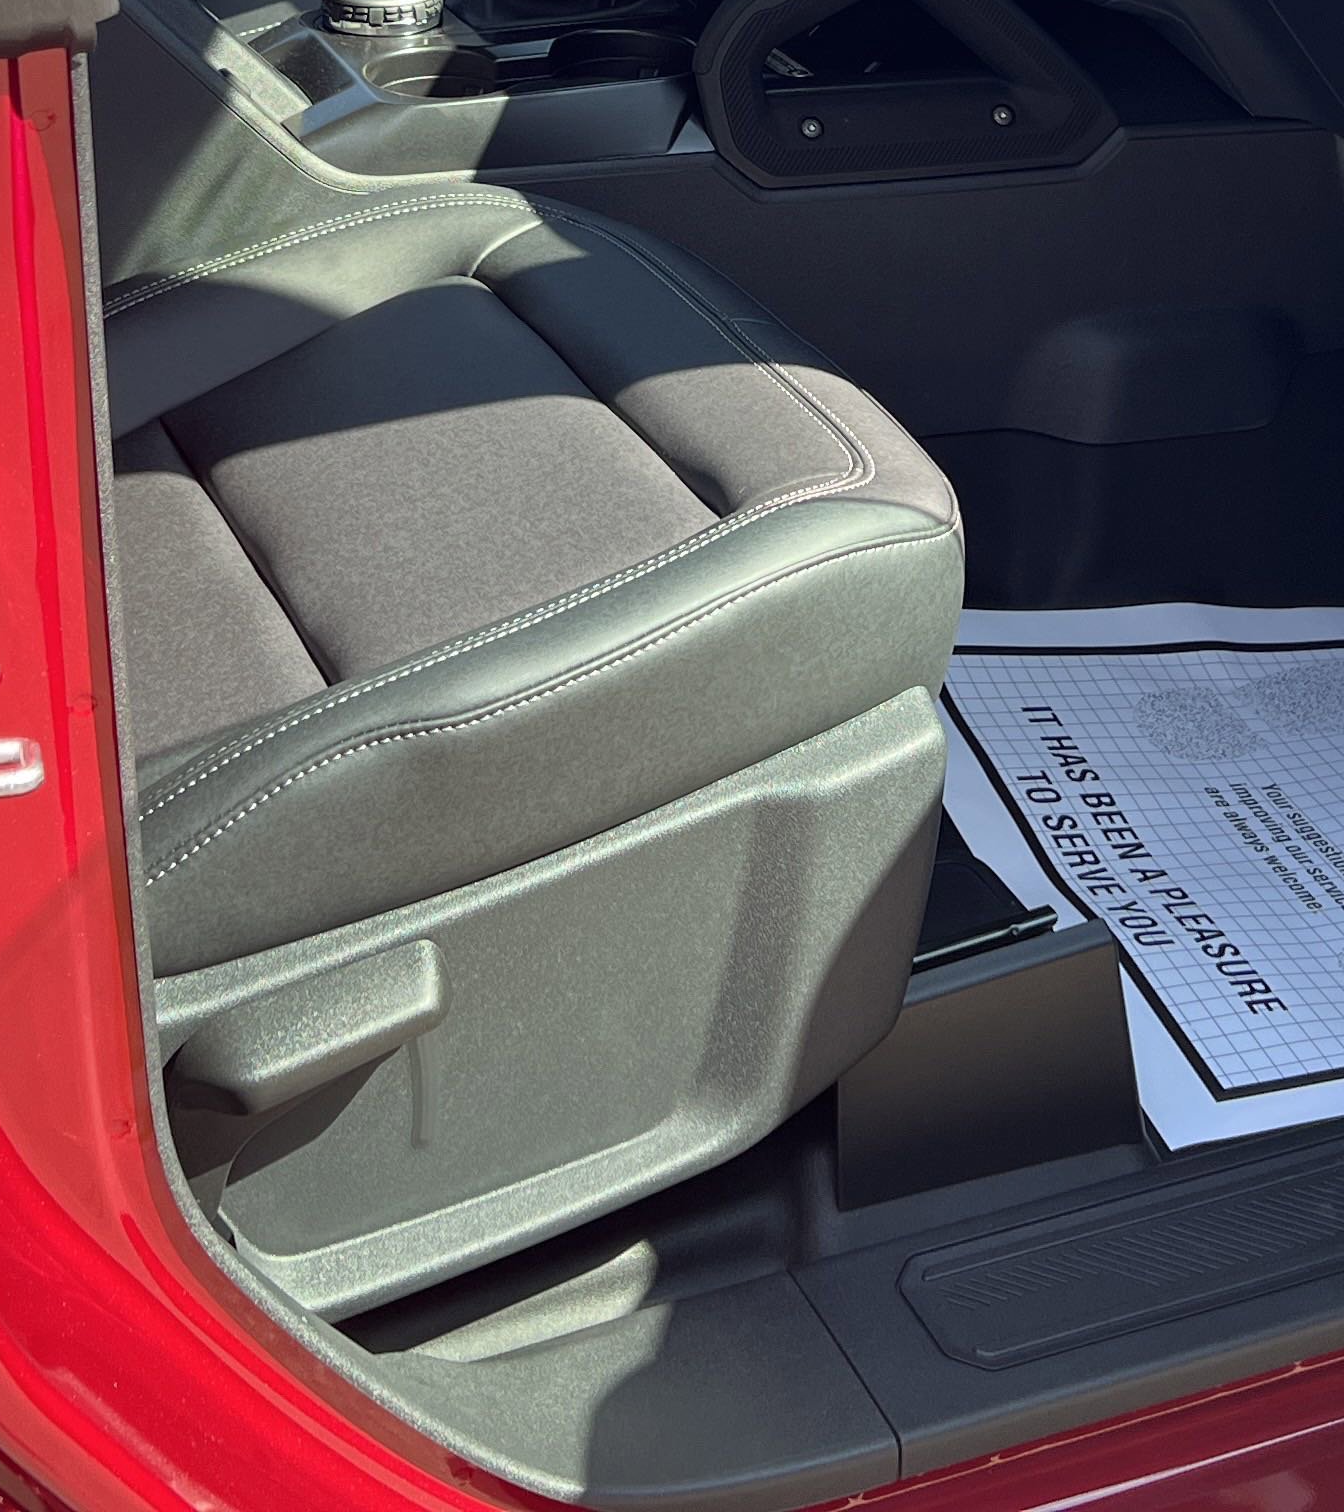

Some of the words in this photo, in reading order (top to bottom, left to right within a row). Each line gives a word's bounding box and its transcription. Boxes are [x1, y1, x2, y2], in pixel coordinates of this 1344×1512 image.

[1021, 706, 1063, 727] IT
[1040, 736, 1100, 782] HAS
[1079, 792, 1152, 860] BEEN
[1229, 782, 1292, 843] improving
[1285, 844, 1314, 865] our
[1260, 782, 1294, 810] Your
[1016, 770, 1062, 804] TO
[1042, 814, 1127, 896] SERVE
[1107, 900, 1175, 946] YOU
[1129, 867, 1168, 883] A
[1204, 786, 1230, 808] are
[1223, 810, 1270, 853] always
[1263, 854, 1323, 914] welcome.
[1149, 887, 1288, 1014] PLEASURE
